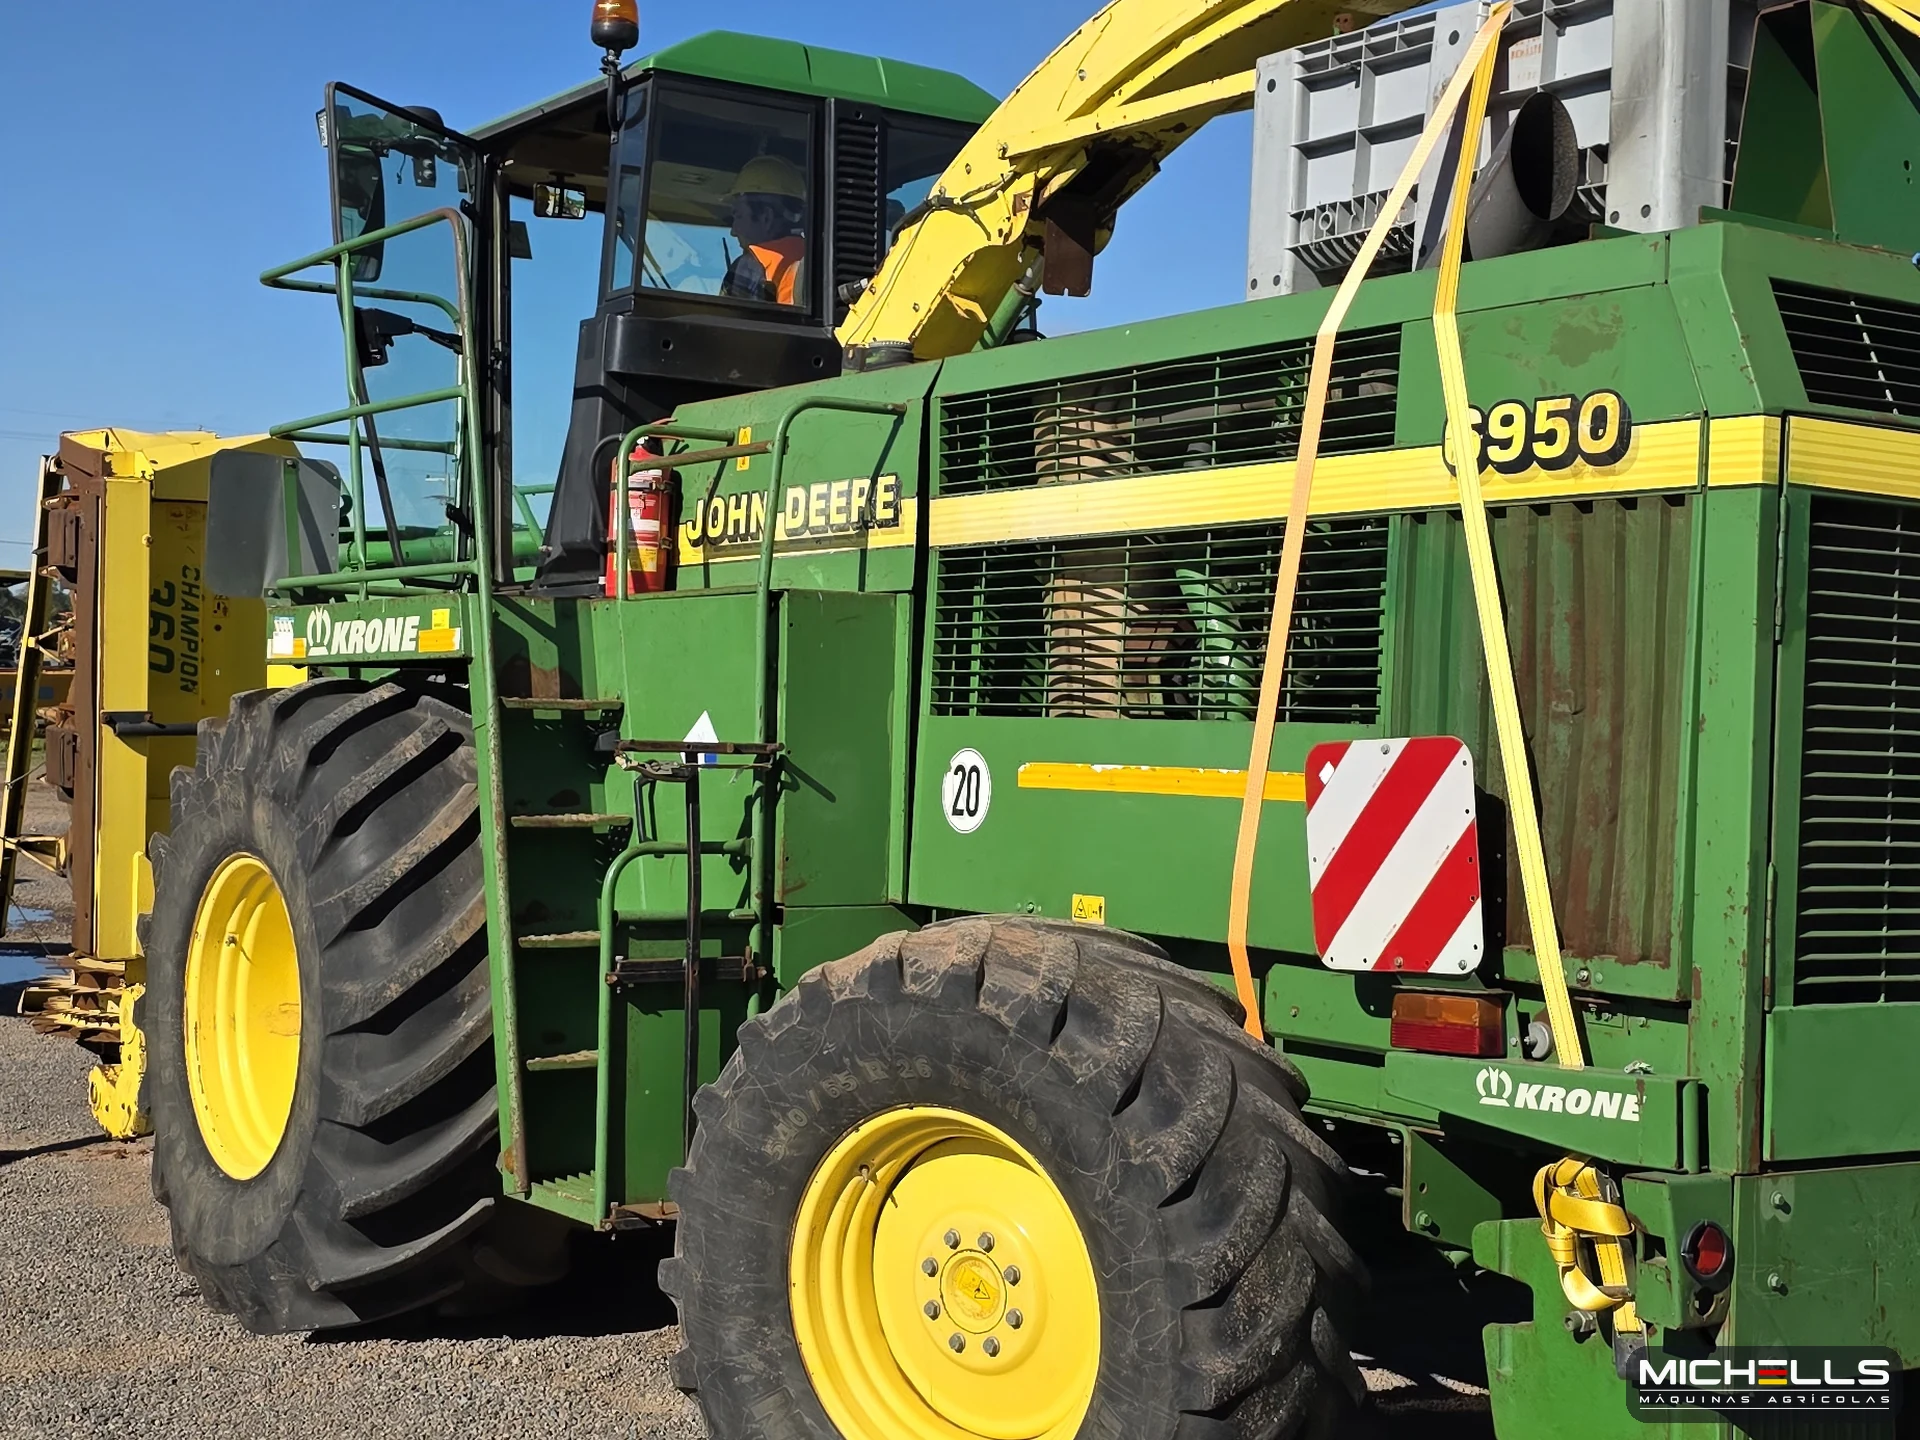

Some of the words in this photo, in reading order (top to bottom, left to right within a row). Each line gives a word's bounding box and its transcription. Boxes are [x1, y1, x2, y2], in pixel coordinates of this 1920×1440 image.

[686, 491, 768, 547] JOHN
[784, 474, 900, 536] DEERE
[150, 580, 176, 674] 360
[180, 564, 201, 693] CHAMPION
[330, 615, 420, 655] KRONE
[951, 764, 981, 817] 20
[1513, 1082, 1647, 1122] KRONE
